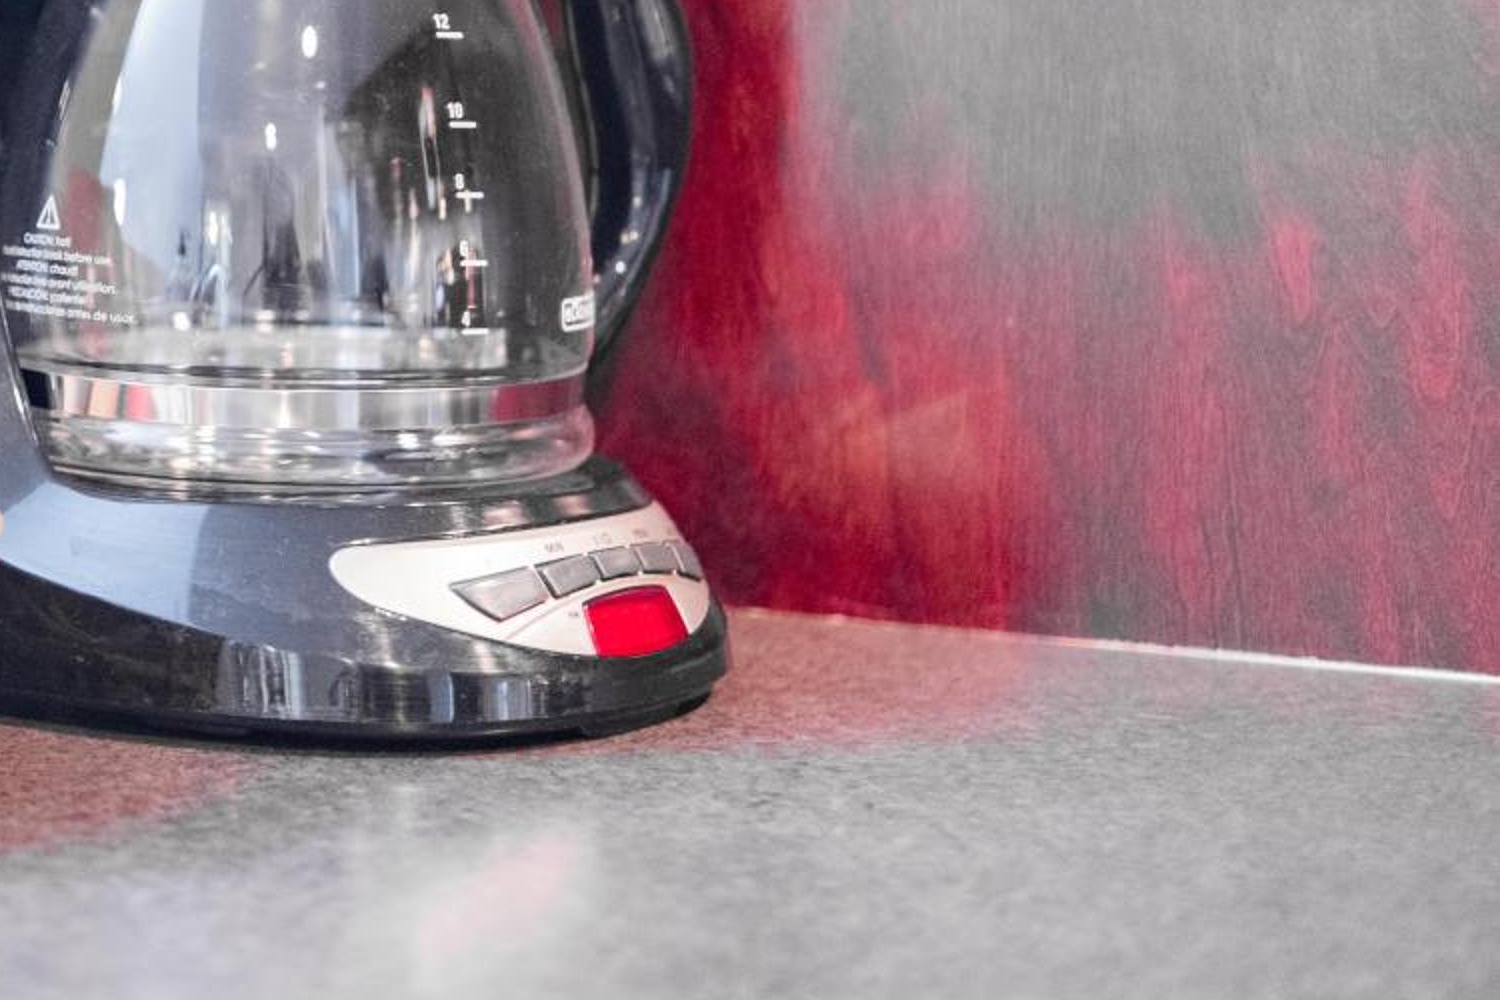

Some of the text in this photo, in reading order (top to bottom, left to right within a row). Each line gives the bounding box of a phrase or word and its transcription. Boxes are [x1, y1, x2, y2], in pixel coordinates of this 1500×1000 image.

[432, 13, 451, 30] 12
[446, 101, 464, 119] 10
[454, 173, 465, 190] 8
[461, 311, 471, 327] 4
